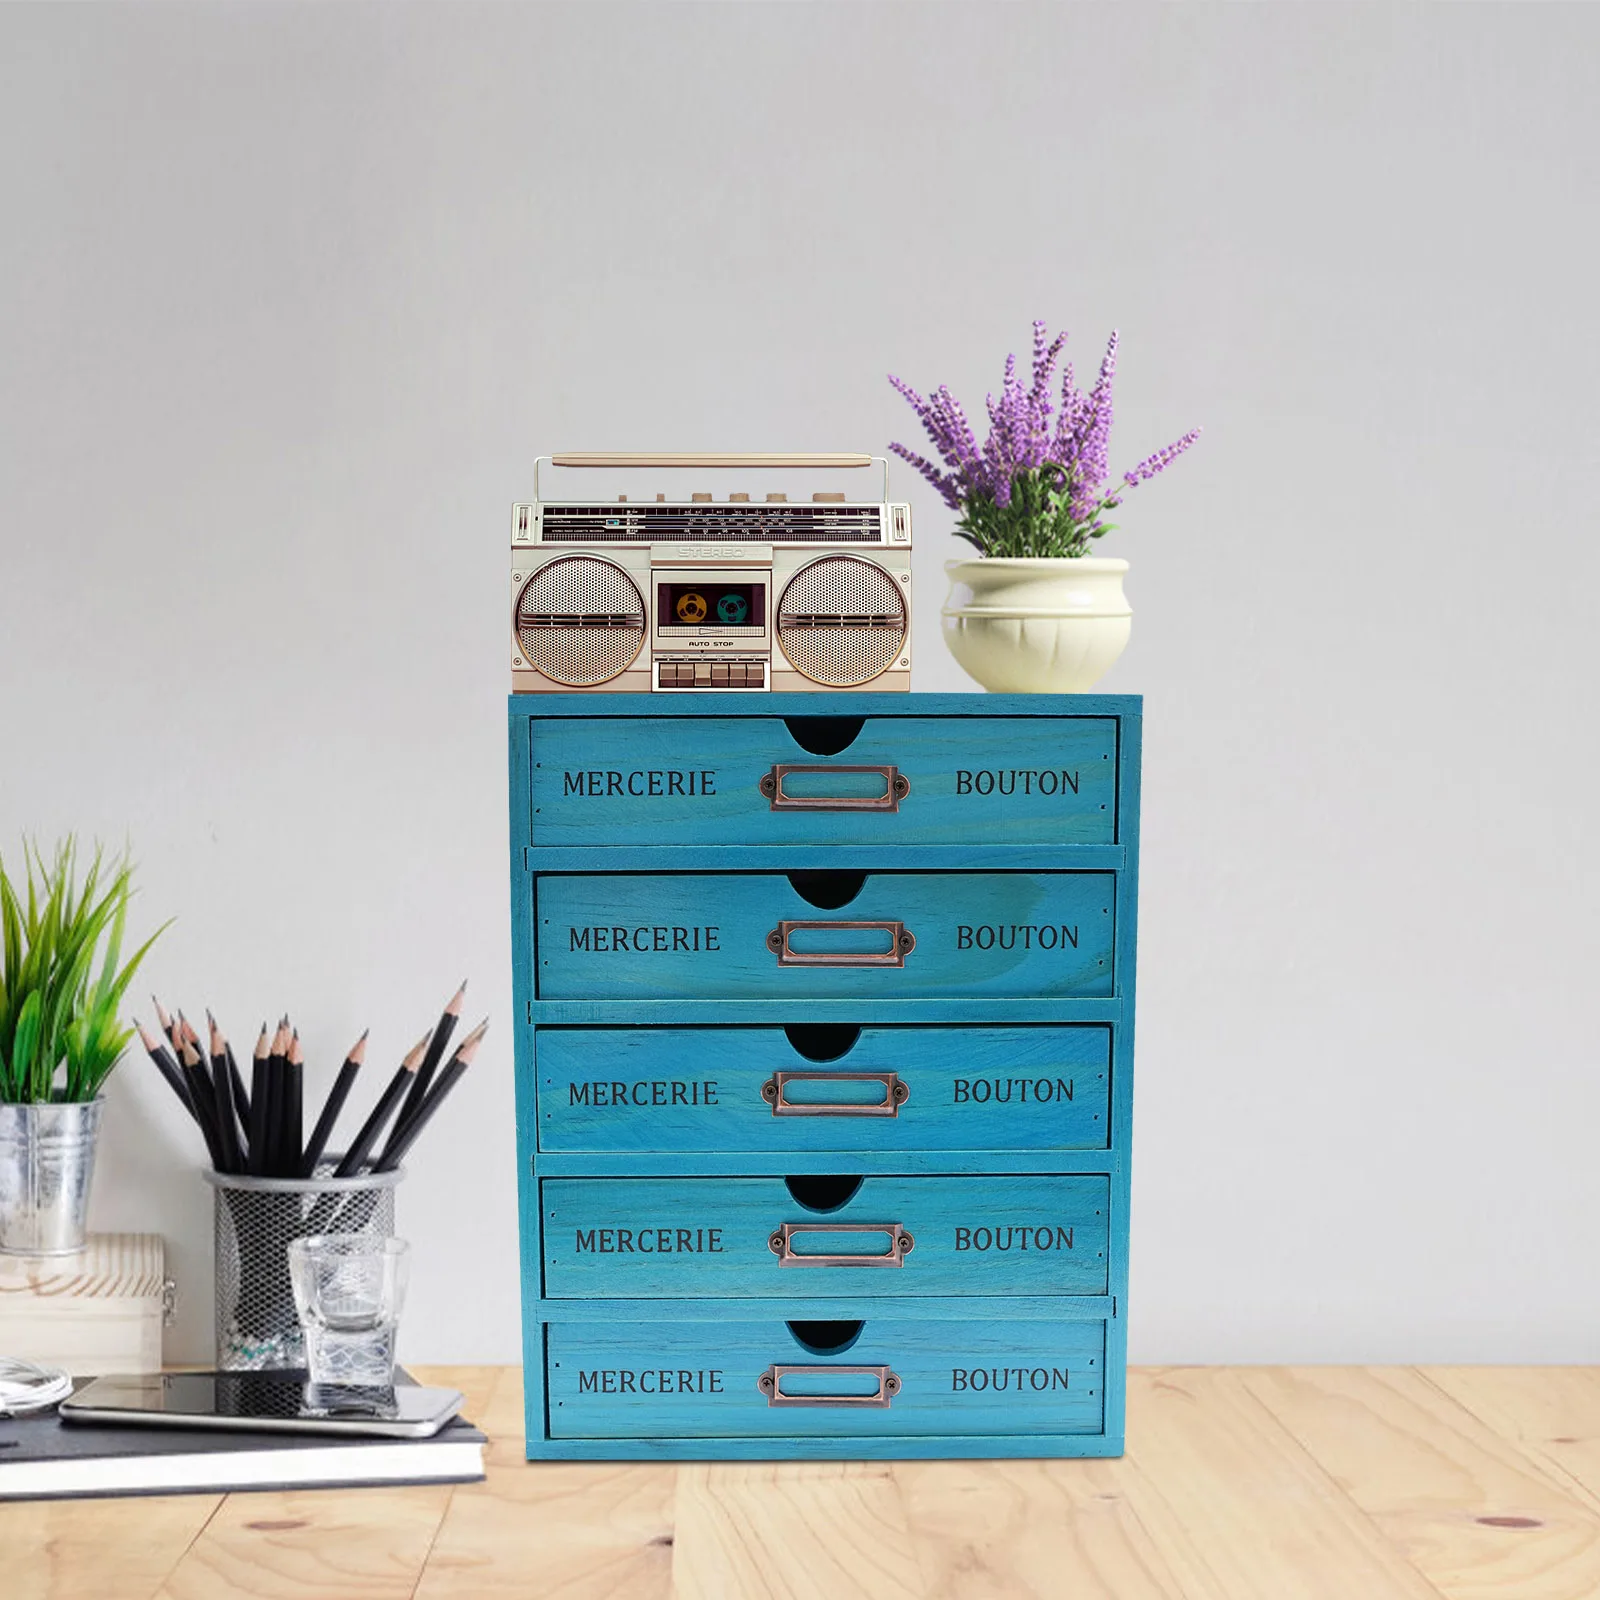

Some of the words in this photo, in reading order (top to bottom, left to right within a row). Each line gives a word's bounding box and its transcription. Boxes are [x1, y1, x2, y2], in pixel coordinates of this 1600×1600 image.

[678, 547, 745, 558] STEREO
[564, 771, 717, 797] MERCERIE
[957, 771, 1078, 796] BOUTON
[570, 927, 721, 952] MERCERIE
[958, 925, 1078, 951] BOUTON
[570, 1081, 719, 1106] MERCERIE
[954, 1079, 1074, 1103] BOUTON
[576, 1228, 724, 1253] MERCERIE
[955, 1226, 1074, 1251] BOUTON
[580, 1370, 724, 1393] MERCERIE
[953, 1368, 1068, 1391] BOUTON
